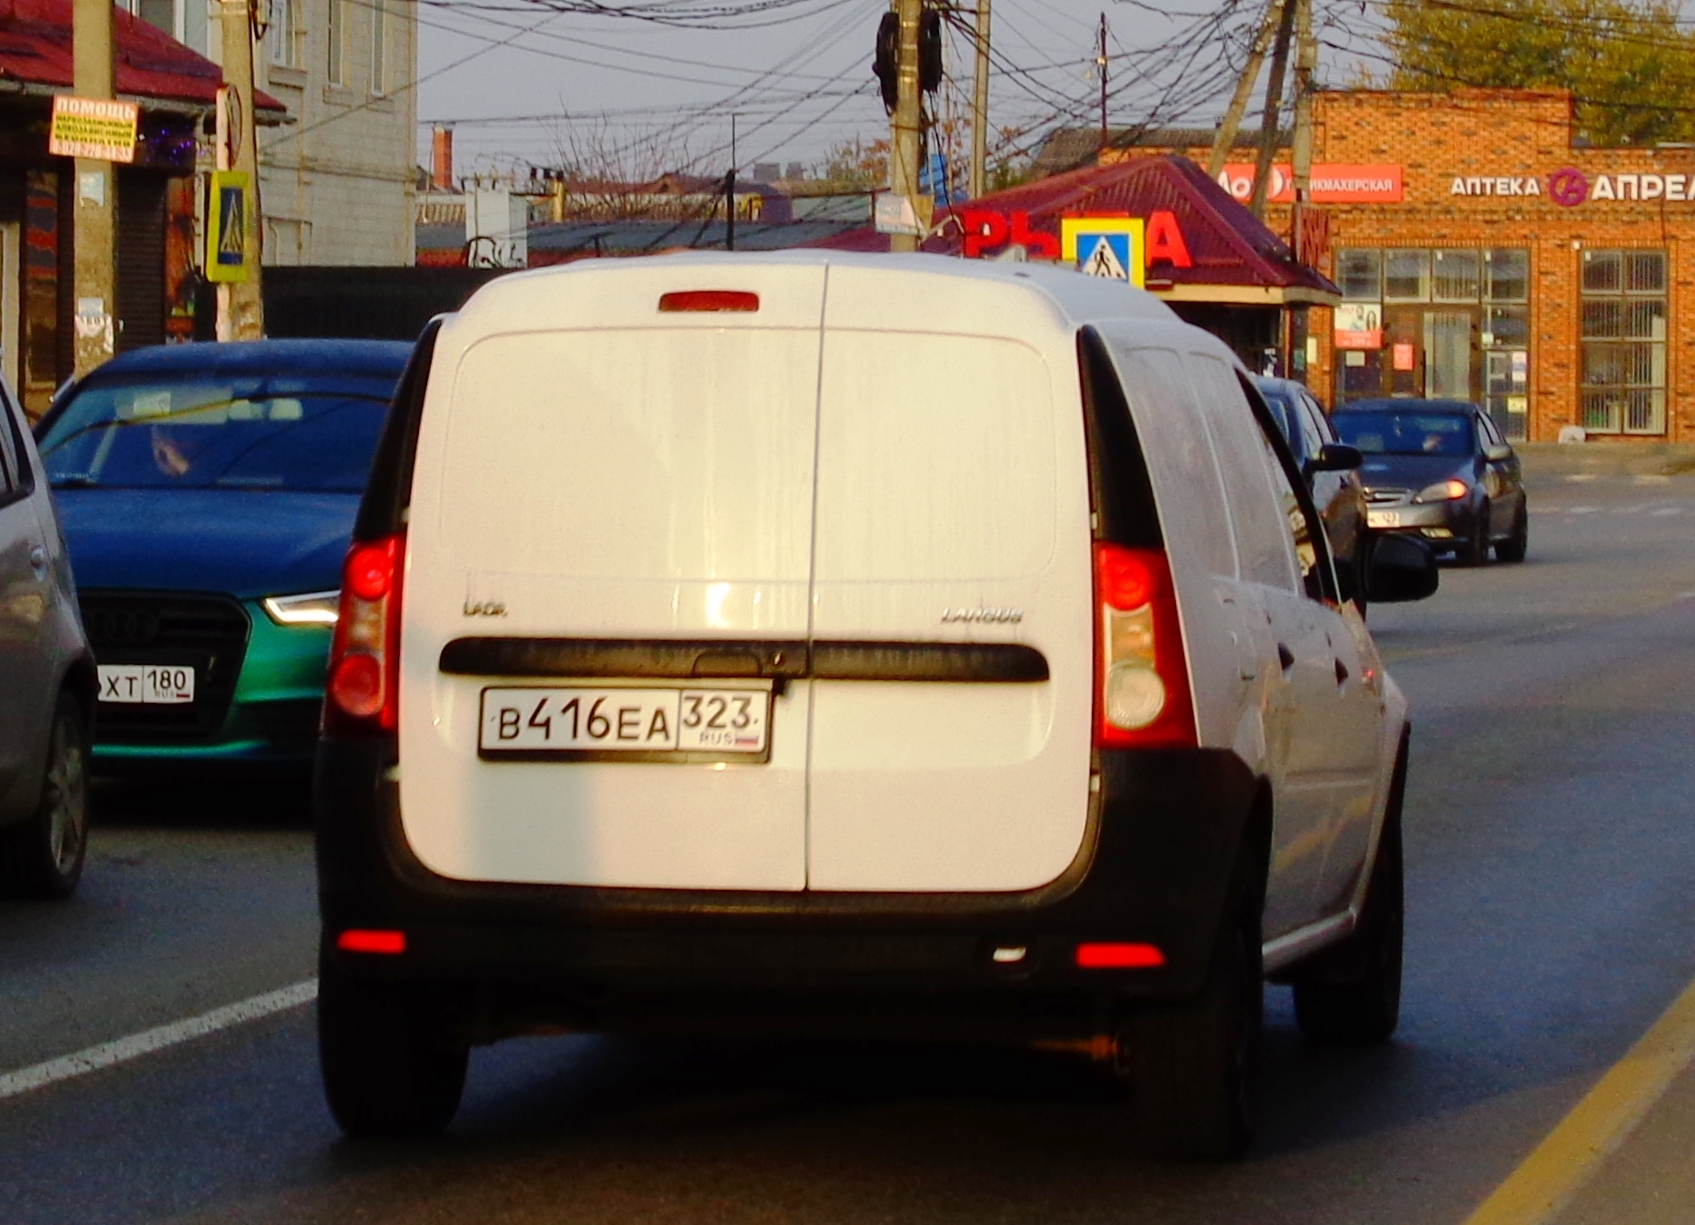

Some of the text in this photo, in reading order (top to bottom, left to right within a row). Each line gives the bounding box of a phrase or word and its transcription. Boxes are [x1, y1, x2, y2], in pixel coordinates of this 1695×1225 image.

[56, 100, 136, 120] ПОМОЩЬ
[1286, 178, 1393, 192] ПИКМАХЕРСКАЯ
[1450, 177, 1541, 196] АПТЕКА
[147, 669, 187, 691] 180
[498, 697, 753, 742] В416ЕА 323
[700, 731, 732, 746] RUS
